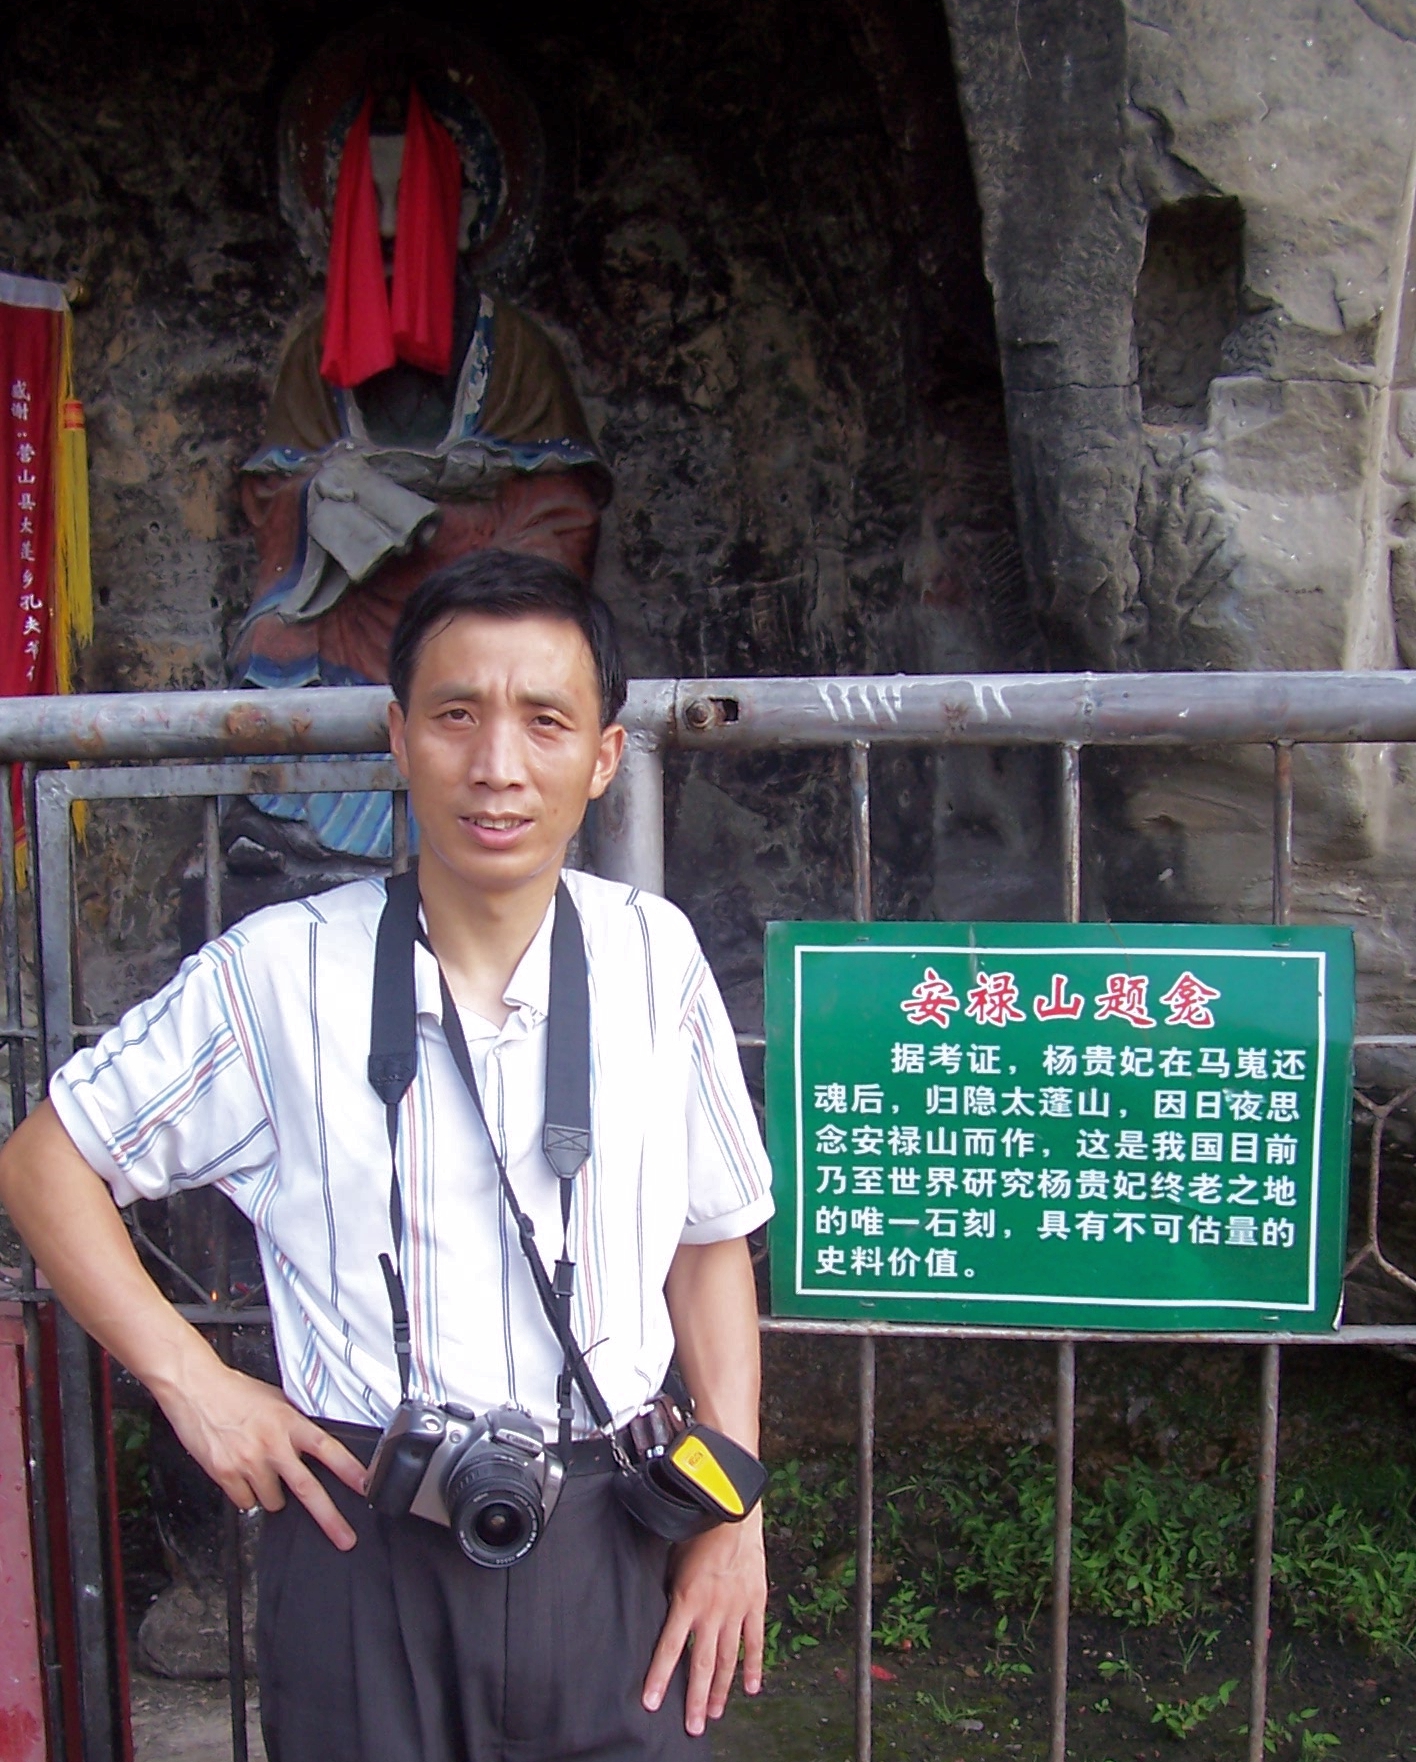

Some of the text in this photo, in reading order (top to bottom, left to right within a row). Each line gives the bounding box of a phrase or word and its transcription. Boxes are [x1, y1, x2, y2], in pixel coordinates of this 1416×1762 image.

[900, 967, 1221, 1029] 安禄山题龛
[890, 1042, 1306, 1080] 据考证，杨贵妃在马嵬还
[814, 1083, 1300, 1122] 魂后，归隐太蓬山，因日夜思
[815, 1124, 1298, 1164] 念安禄山而作，这是我国目前
[816, 1166, 1297, 1206] 乃至世界研究杨贵妃终老之地
[815, 1206, 1295, 1248] 的唯一石刻，具有不可估量的
[815, 1246, 981, 1278] 史料价值。
